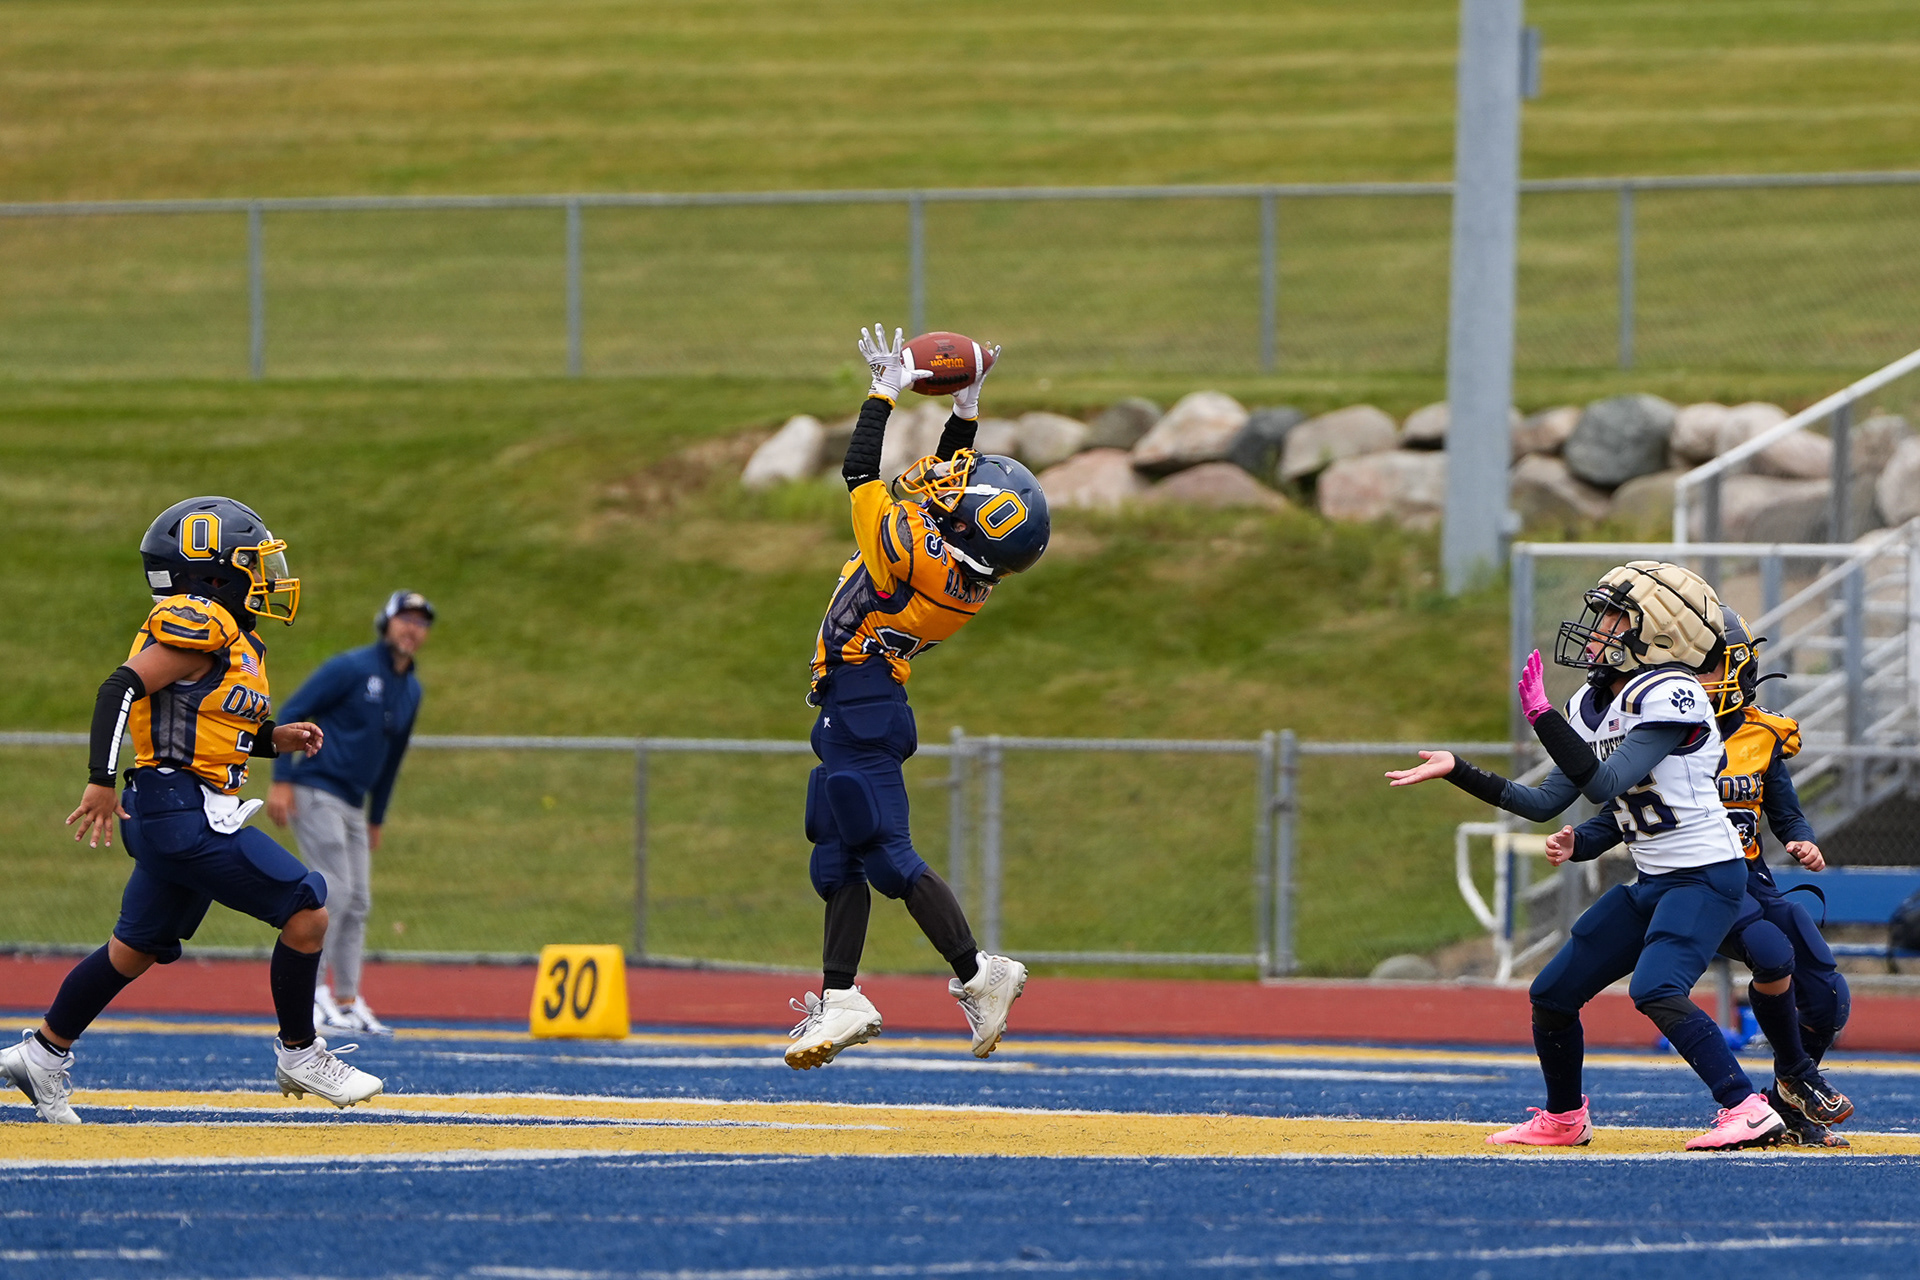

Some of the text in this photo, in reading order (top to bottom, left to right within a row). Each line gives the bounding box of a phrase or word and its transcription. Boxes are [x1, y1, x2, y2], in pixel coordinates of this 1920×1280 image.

[930, 358, 965, 369] Wilson
[179, 511, 222, 562] O
[974, 488, 1029, 541] O
[1738, 744, 1761, 761] 42
[544, 958, 598, 1020] 30
